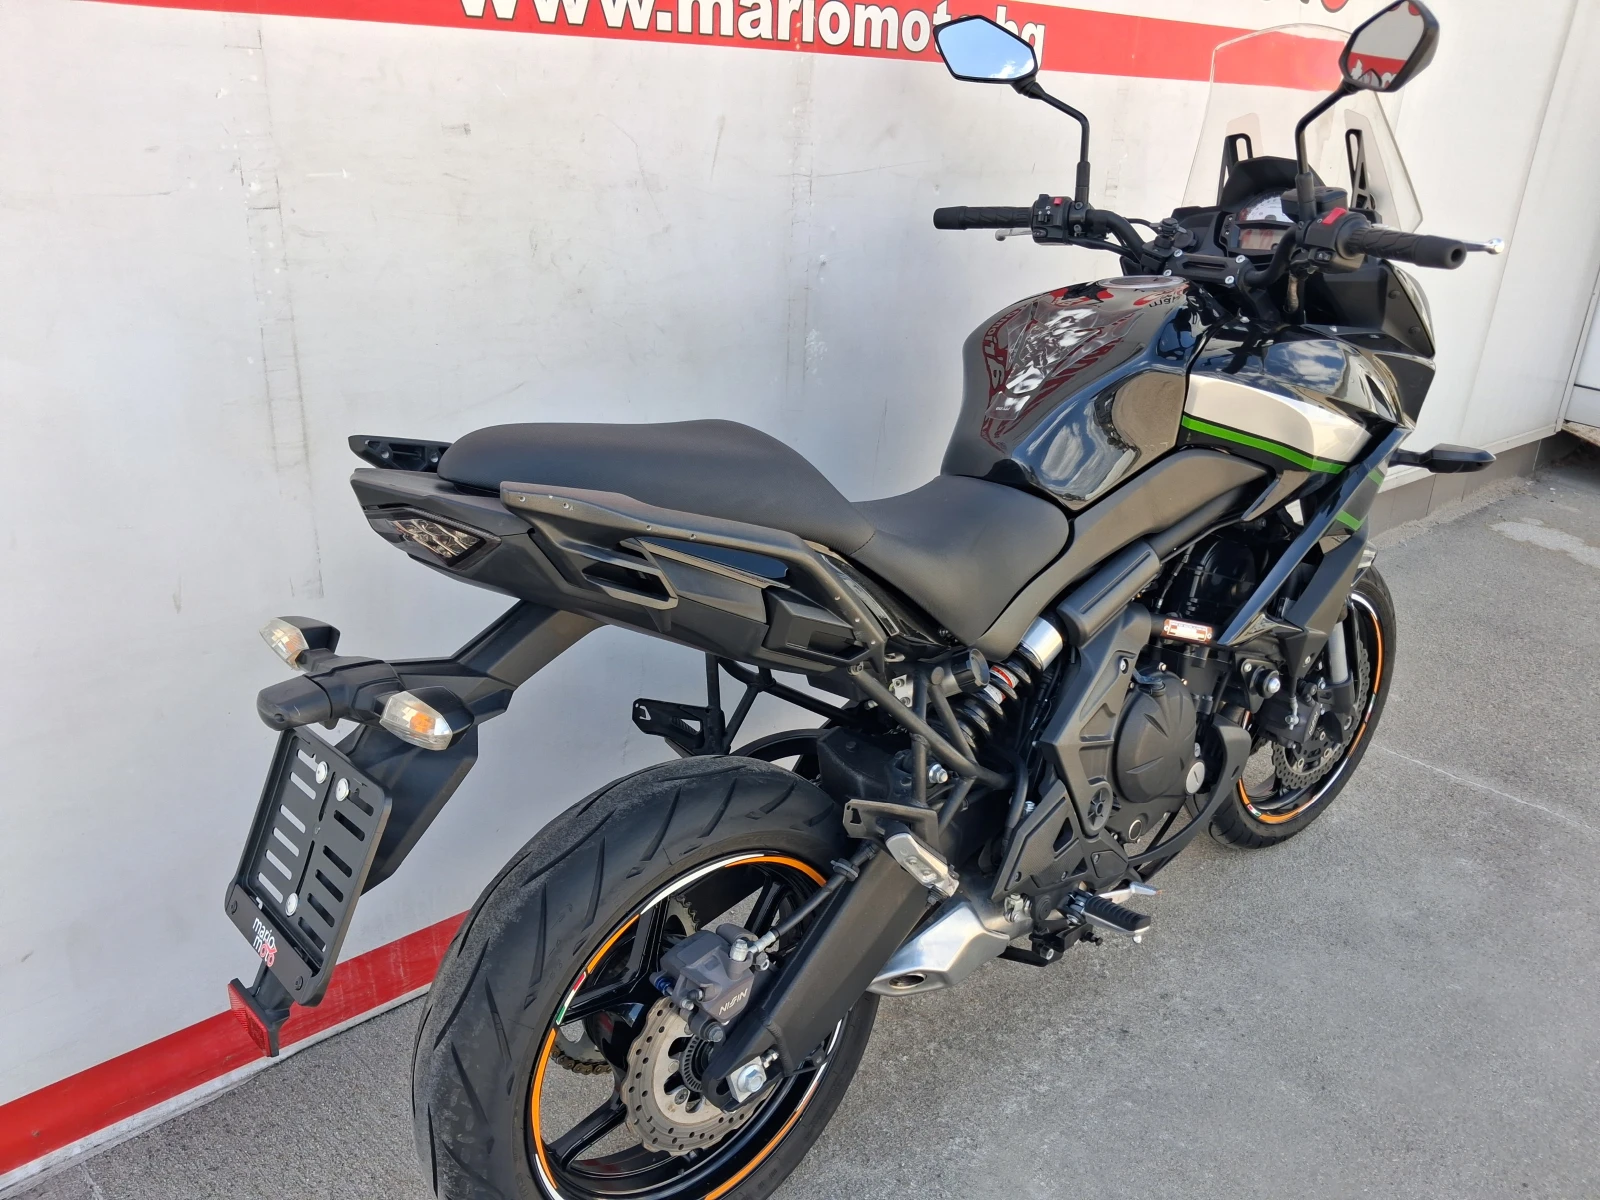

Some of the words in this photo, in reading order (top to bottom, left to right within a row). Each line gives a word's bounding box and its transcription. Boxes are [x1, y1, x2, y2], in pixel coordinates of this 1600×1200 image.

[460, 0, 1046, 71] w.mariomotg
[252, 918, 275, 948] mario
[253, 935, 275, 967] moto
[718, 988, 748, 1016] NISSIN
